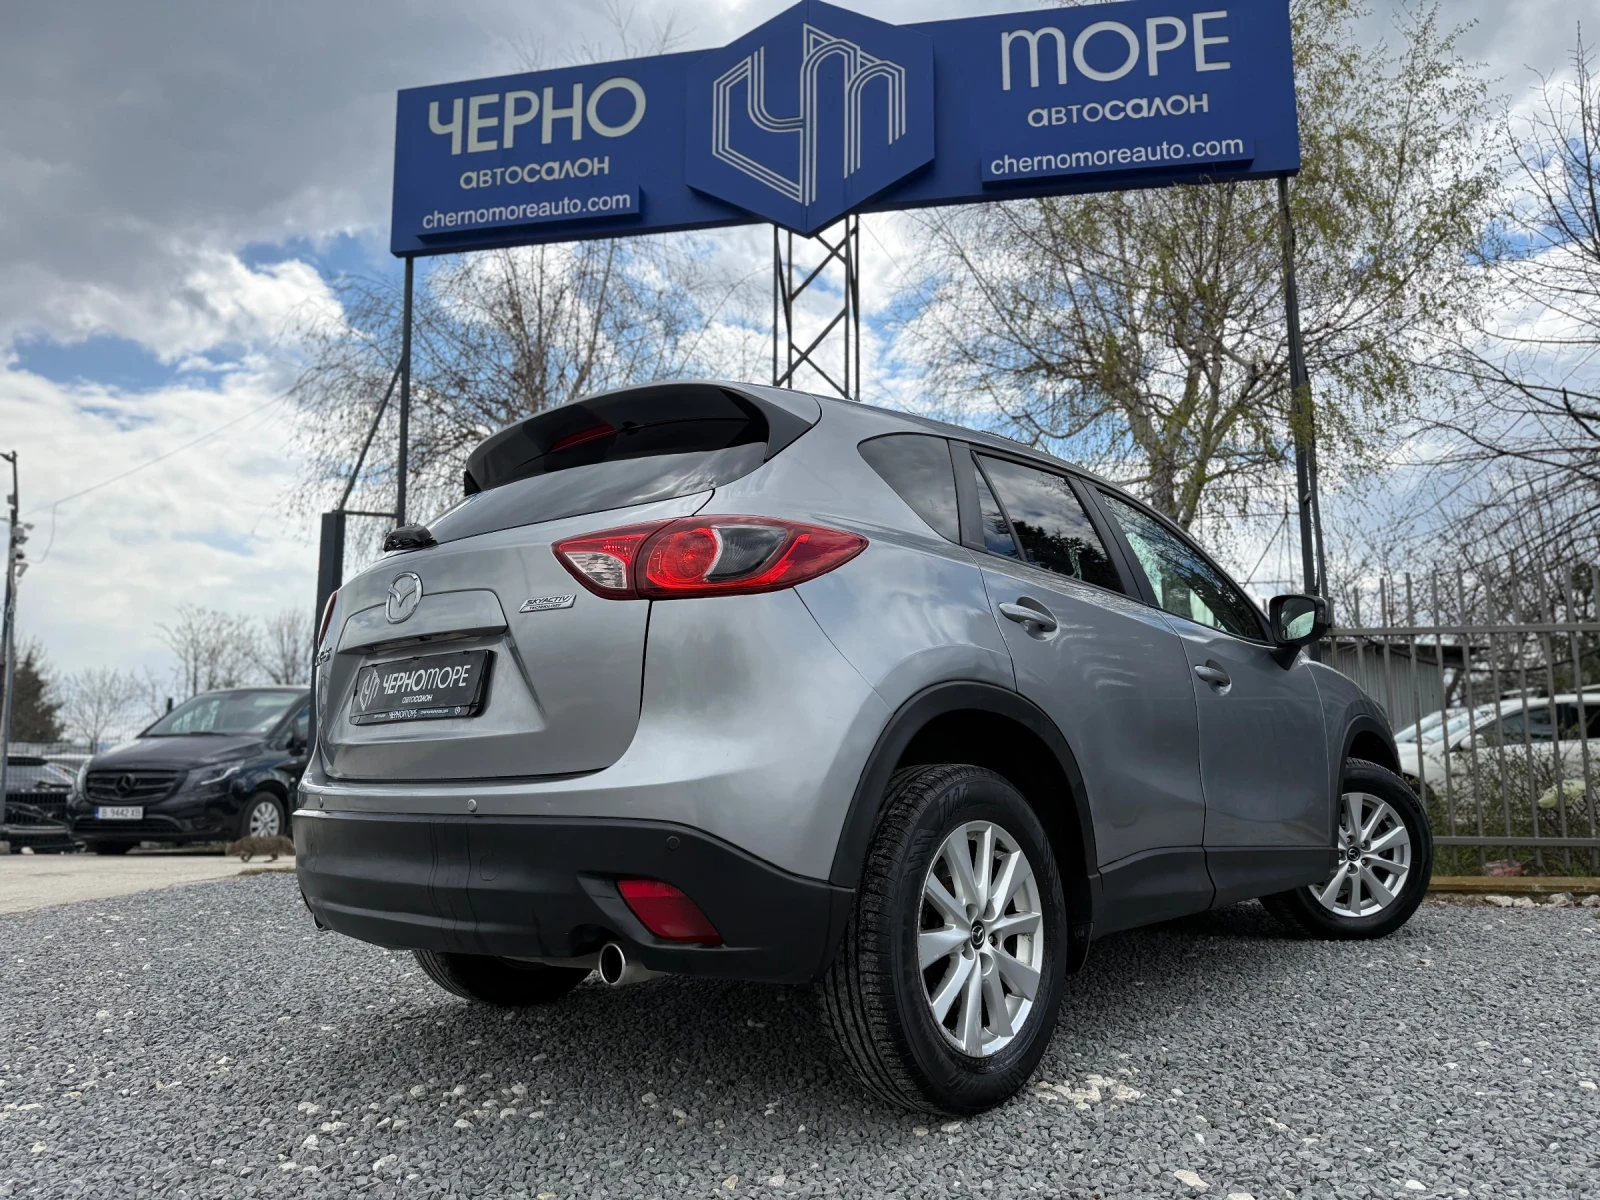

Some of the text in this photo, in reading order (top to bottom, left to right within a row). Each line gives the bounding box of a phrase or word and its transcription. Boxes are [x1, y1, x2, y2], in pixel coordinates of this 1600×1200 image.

[1000, 10, 1231, 91] МОРЕ
[428, 76, 646, 156] ЧЕРНО
[990, 138, 1244, 175] chernomoreauto.com
[421, 192, 631, 229] chernomoreauto.com
[527, 595, 572, 605] SKYACTIV
[383, 665, 471, 695] ЧЕРНОМОРЕ
